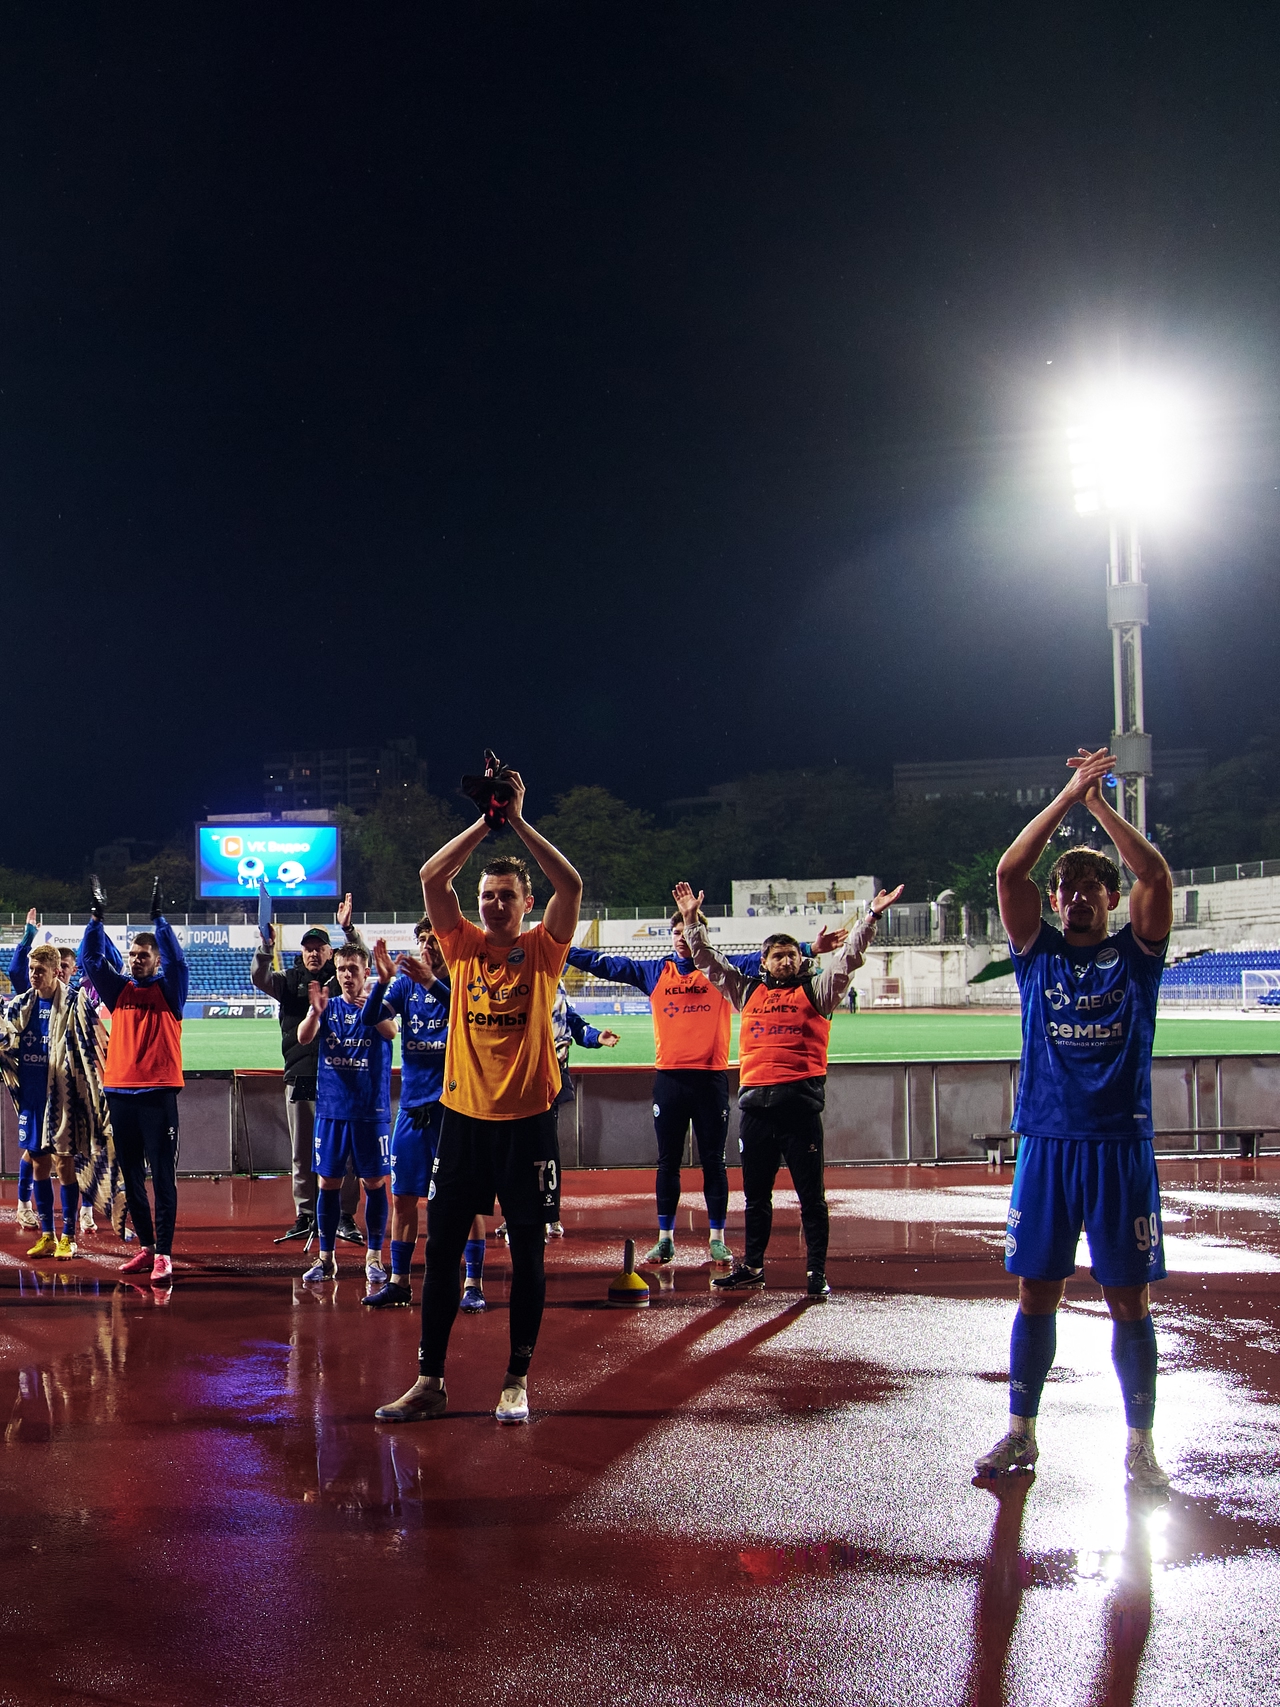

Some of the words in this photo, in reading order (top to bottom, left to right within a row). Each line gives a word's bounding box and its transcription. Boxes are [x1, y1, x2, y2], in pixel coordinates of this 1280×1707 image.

[247, 841, 267, 853] VK
[187, 931, 229, 945] ГОРОДА
[490, 983, 530, 1002] ДЕЛО
[664, 985, 701, 996] KELME
[1075, 989, 1125, 1011] ДЕЛО
[208, 1006, 244, 1016] PARI
[683, 1004, 711, 1014] ДЕЛО
[768, 1025, 803, 1035] ДЕЛО
[343, 1038, 372, 1048] ДЕЛО
[378, 1135, 389, 1157] 17
[533, 1160, 558, 1191] 73
[1133, 1212, 1160, 1251] 99
